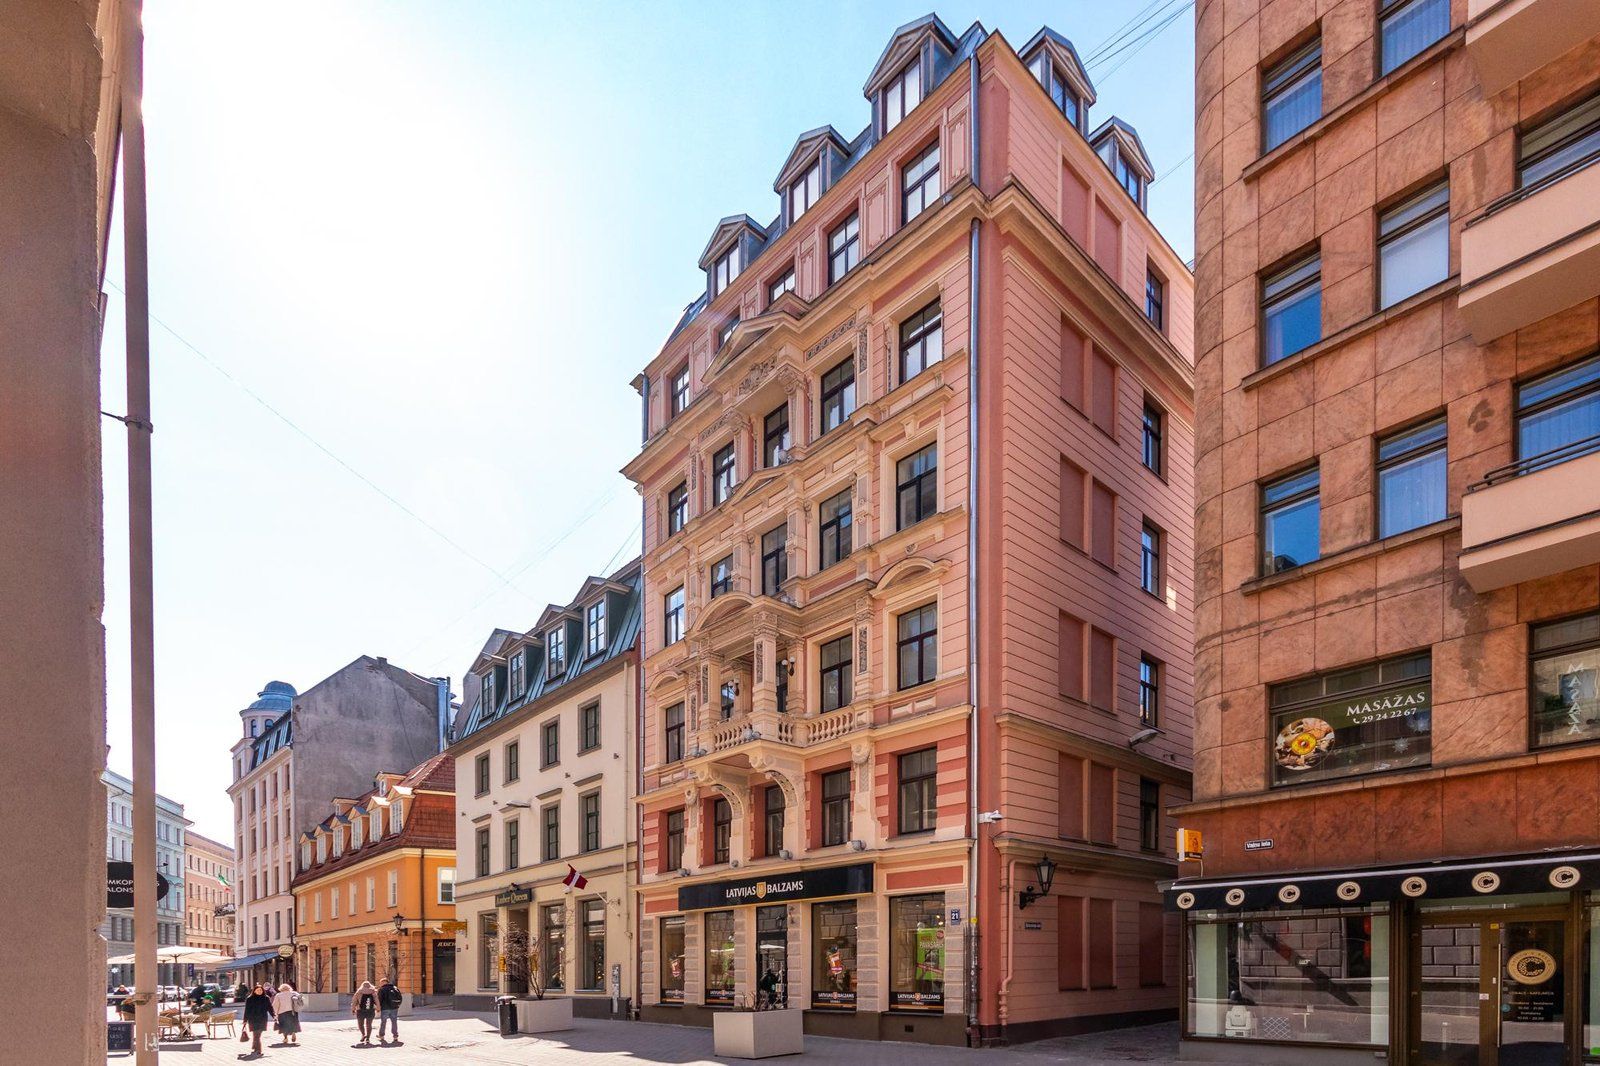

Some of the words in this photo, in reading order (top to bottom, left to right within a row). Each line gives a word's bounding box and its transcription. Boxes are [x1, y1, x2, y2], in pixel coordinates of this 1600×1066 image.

[1346, 691, 1426, 717] MASĀŽAS
[1361, 715, 1374, 724] 29
[1375, 712, 1388, 721] 24
[1390, 710, 1403, 719] 22
[1403, 707, 1417, 717] 67
[726, 886, 757, 899] LATVIJAS
[766, 880, 804, 894] BALZAMS
[951, 912, 959, 920] 21
